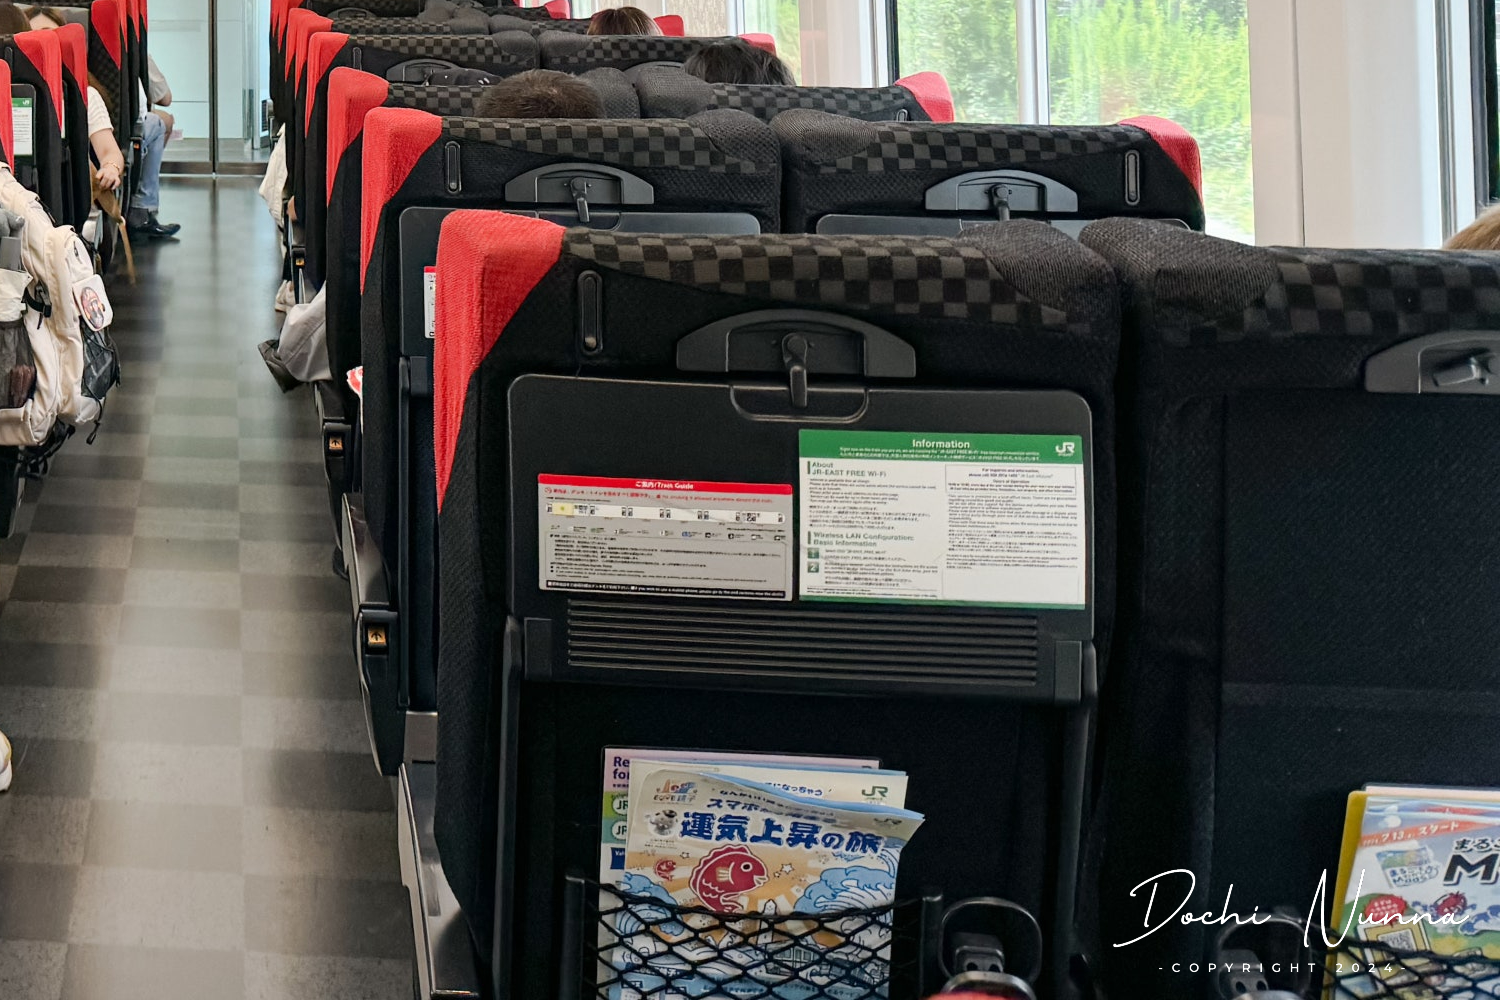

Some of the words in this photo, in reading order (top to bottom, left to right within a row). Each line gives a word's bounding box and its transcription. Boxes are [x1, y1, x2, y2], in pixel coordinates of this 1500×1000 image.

[912, 439, 970, 449] Information
[1055, 442, 1075, 453] JR
[814, 531, 843, 539] Wireless
[766, 782, 823, 796] になっちゃう
[862, 786, 888, 798] JR
[680, 811, 886, 855] 運気上昇の旅
[1419, 822, 1459, 835] スタート
